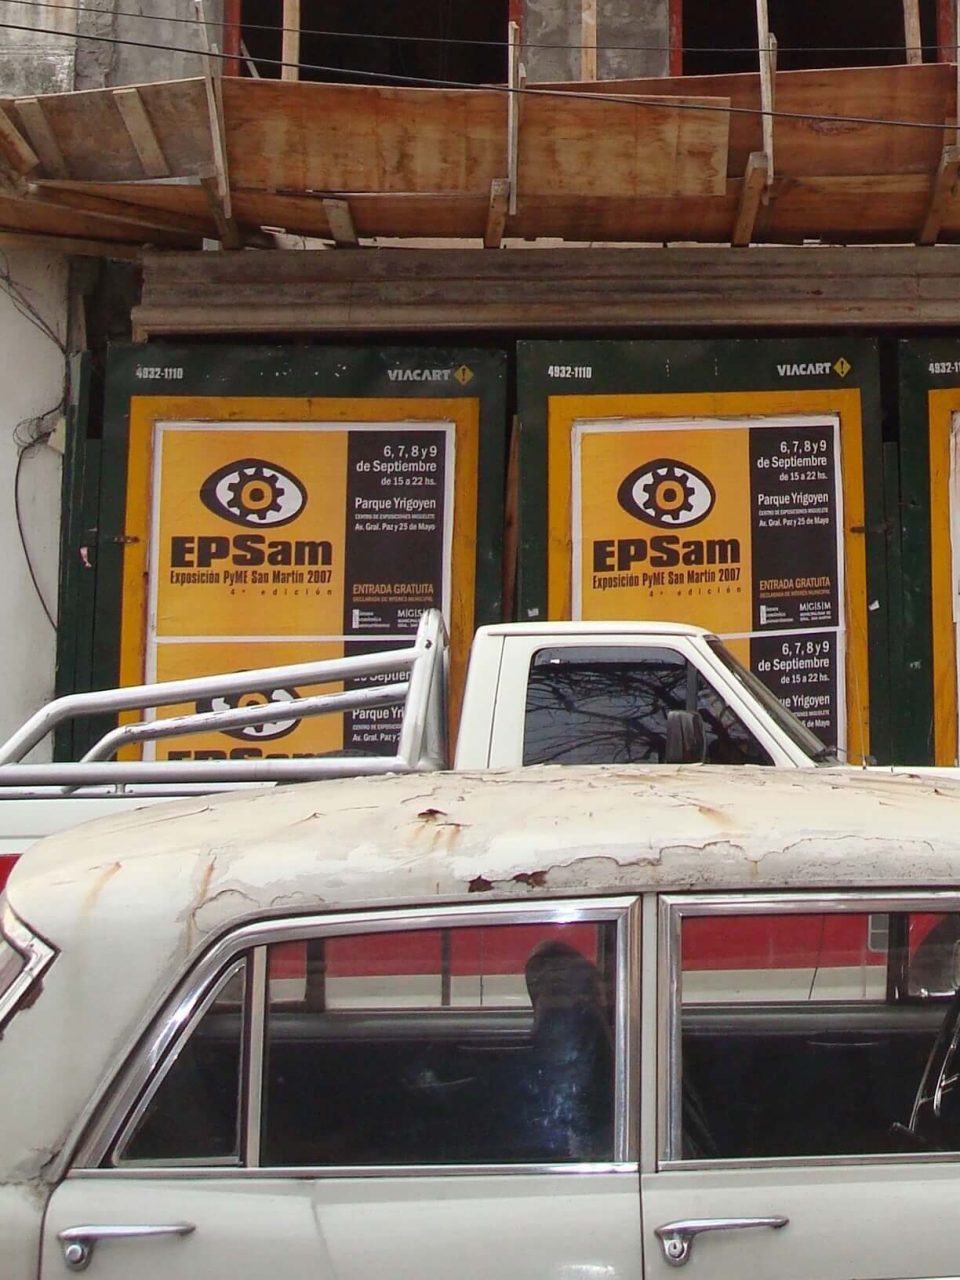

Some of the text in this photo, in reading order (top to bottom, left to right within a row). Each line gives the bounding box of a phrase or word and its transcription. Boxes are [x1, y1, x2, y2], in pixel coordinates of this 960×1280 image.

[387, 369, 450, 381] VIACART
[548, 366, 592, 378] 4932-1110
[777, 363, 831, 376] VIACART
[411, 446, 419, 457] 8
[421, 448, 427, 459] y
[430, 446, 437, 457] 9
[804, 441, 811, 452] 8
[813, 442, 818, 454] y
[820, 440, 827, 451] 9
[356, 460, 437, 474] de Septiembre
[757, 455, 827, 469] de Septiembre
[381, 477, 391, 485] de
[394, 477, 404, 485] 15
[412, 477, 423, 485] 22
[780, 473, 789, 481] de
[790, 472, 799, 480] 15
[806, 472, 816, 480] 22
[355, 497, 436, 511] Parque Yrigoyen
[758, 492, 829, 507] Parque Yrigoyen
[418, 523, 435, 532] Mayo
[814, 517, 829, 525] Mayo
[170, 534, 332, 568] EPSam
[593, 535, 740, 572] EPSam
[170, 570, 332, 586] Exposición PyME San Martín 2007
[593, 568, 740, 591] Exposición PyME San Martín 2007
[760, 576, 831, 590] ENTRADA GRATUITA
[353, 583, 434, 595] ENTRADA GRATUITA
[806, 642, 814, 654] 8
[815, 644, 821, 655] y
[823, 641, 829, 652] 9
[758, 657, 829, 672] de Septiembre
[781, 675, 790, 684] de
[792, 674, 800, 683] 15
[808, 674, 818, 682] 22
[792, 694, 830, 708] Yrigoyen
[352, 708, 389, 722] Parque
